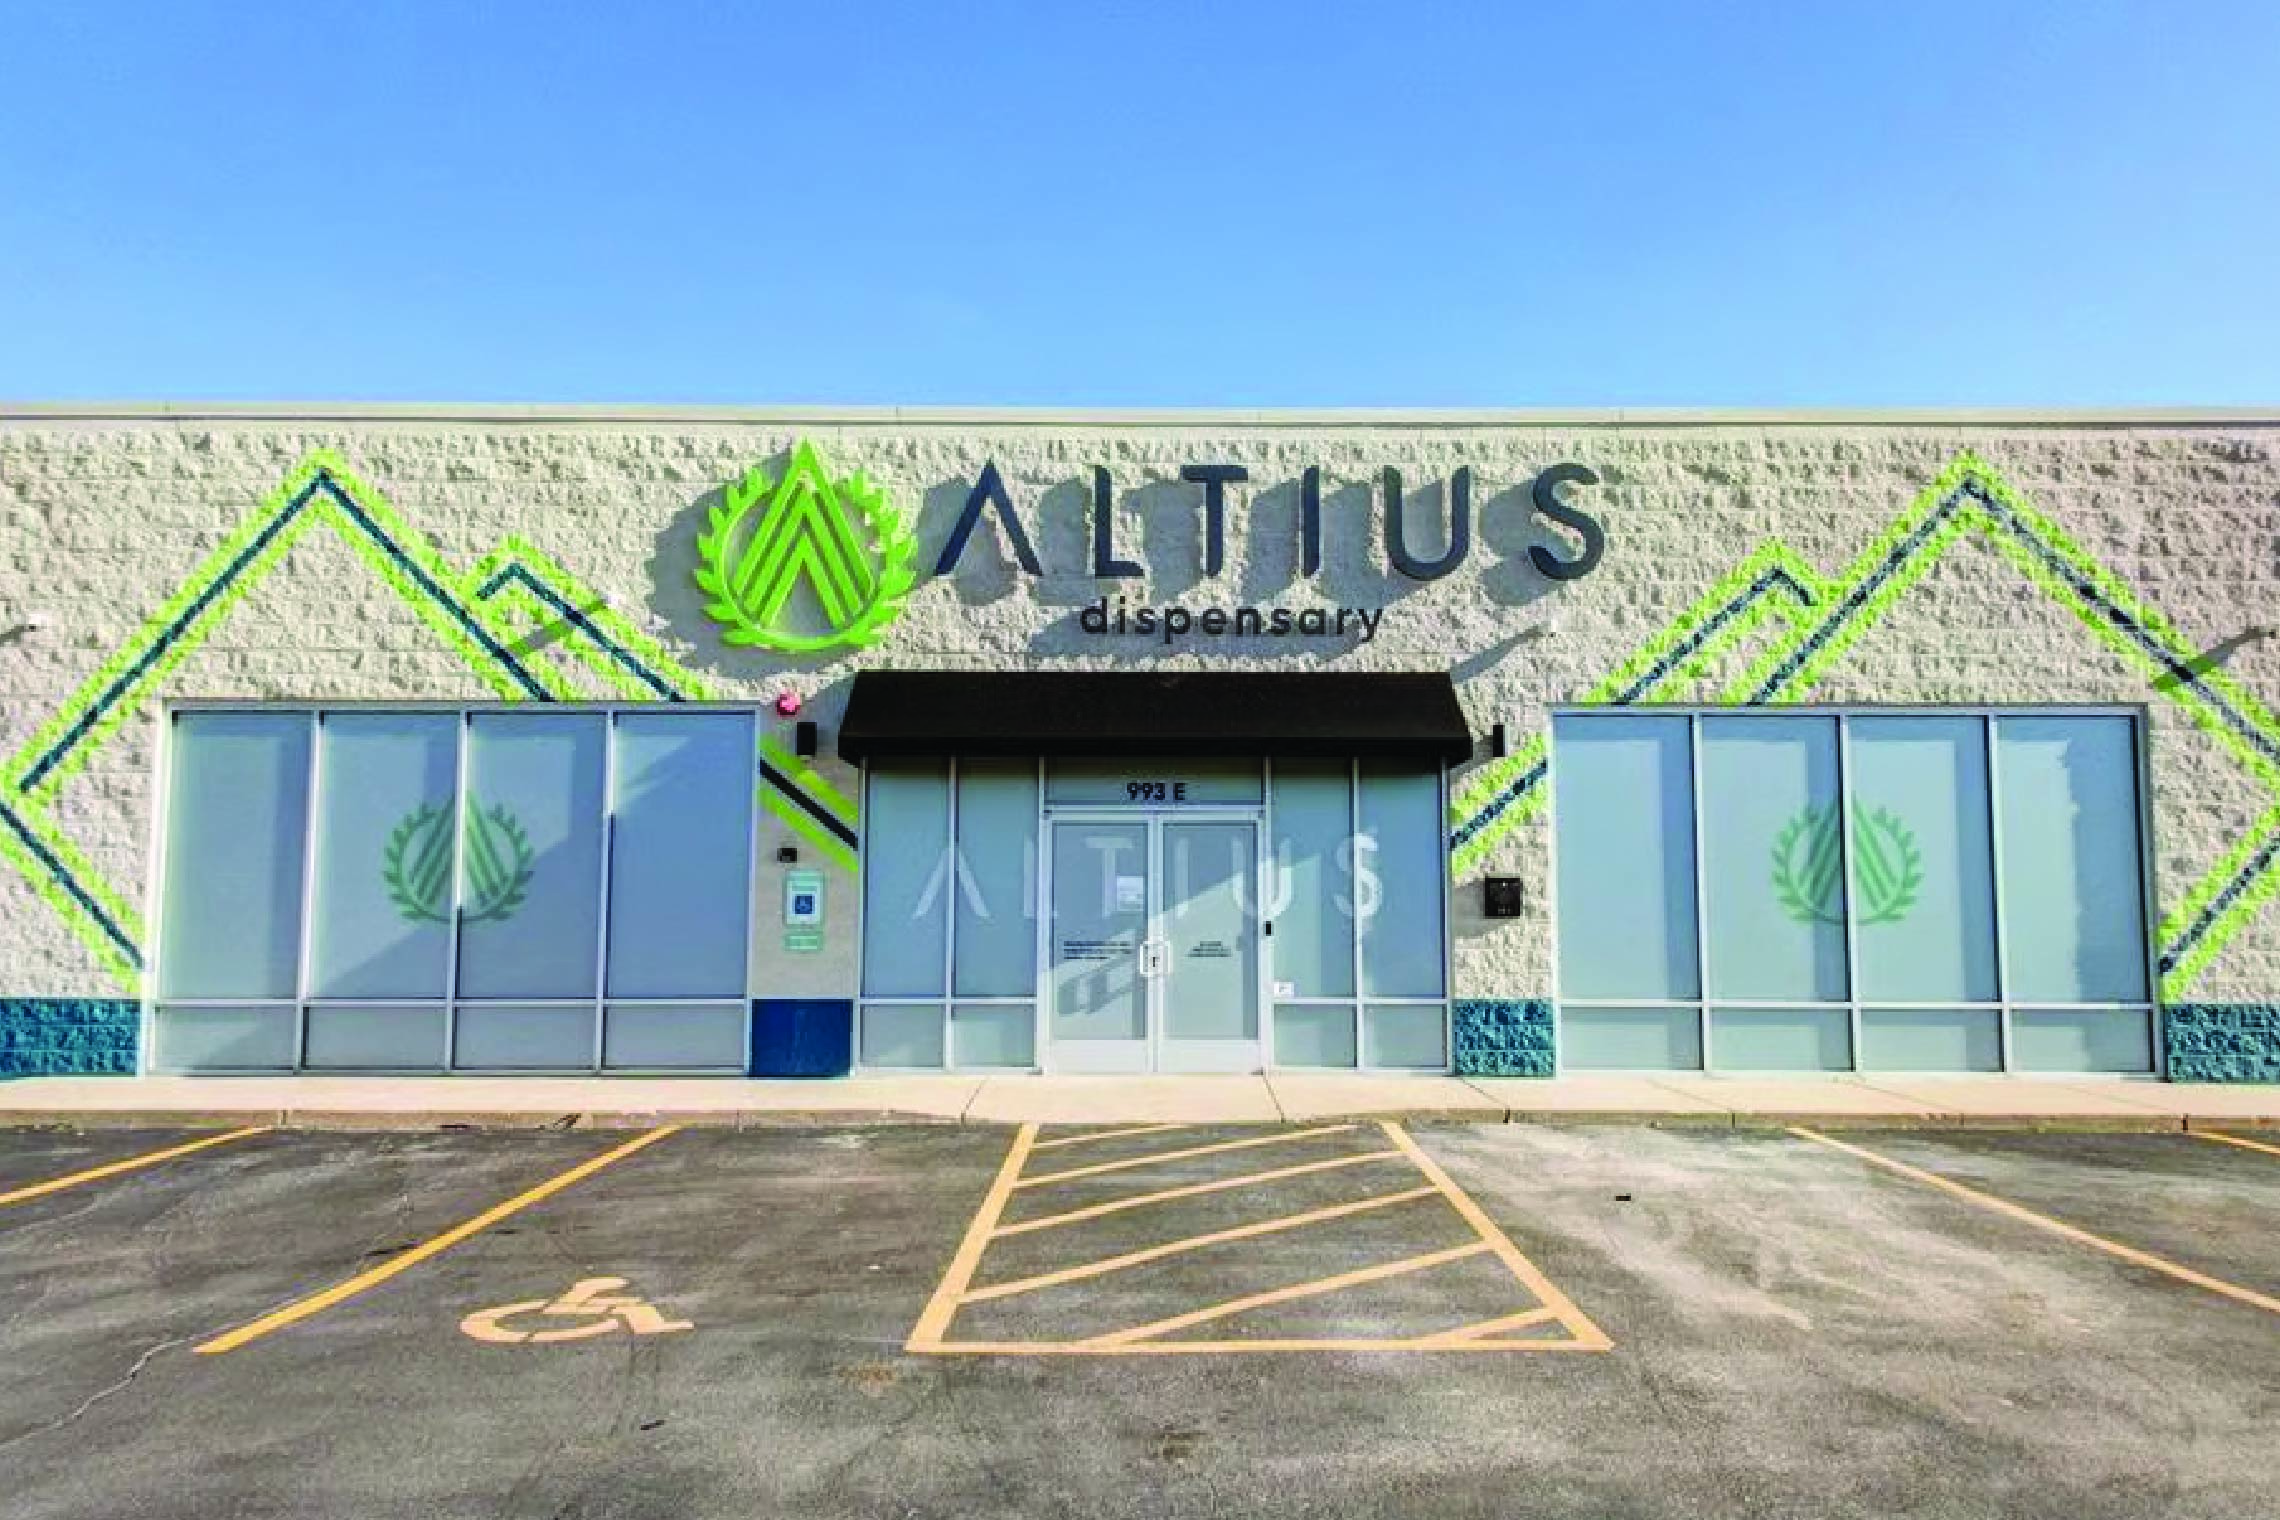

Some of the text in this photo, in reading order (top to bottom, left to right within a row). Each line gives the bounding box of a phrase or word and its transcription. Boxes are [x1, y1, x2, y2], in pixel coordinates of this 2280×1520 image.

[935, 459, 1605, 581] ALTIUS
[1080, 596, 1383, 645] dispensary
[1126, 782, 1186, 801] 993 E
[913, 833, 1382, 921] ALTIUS
